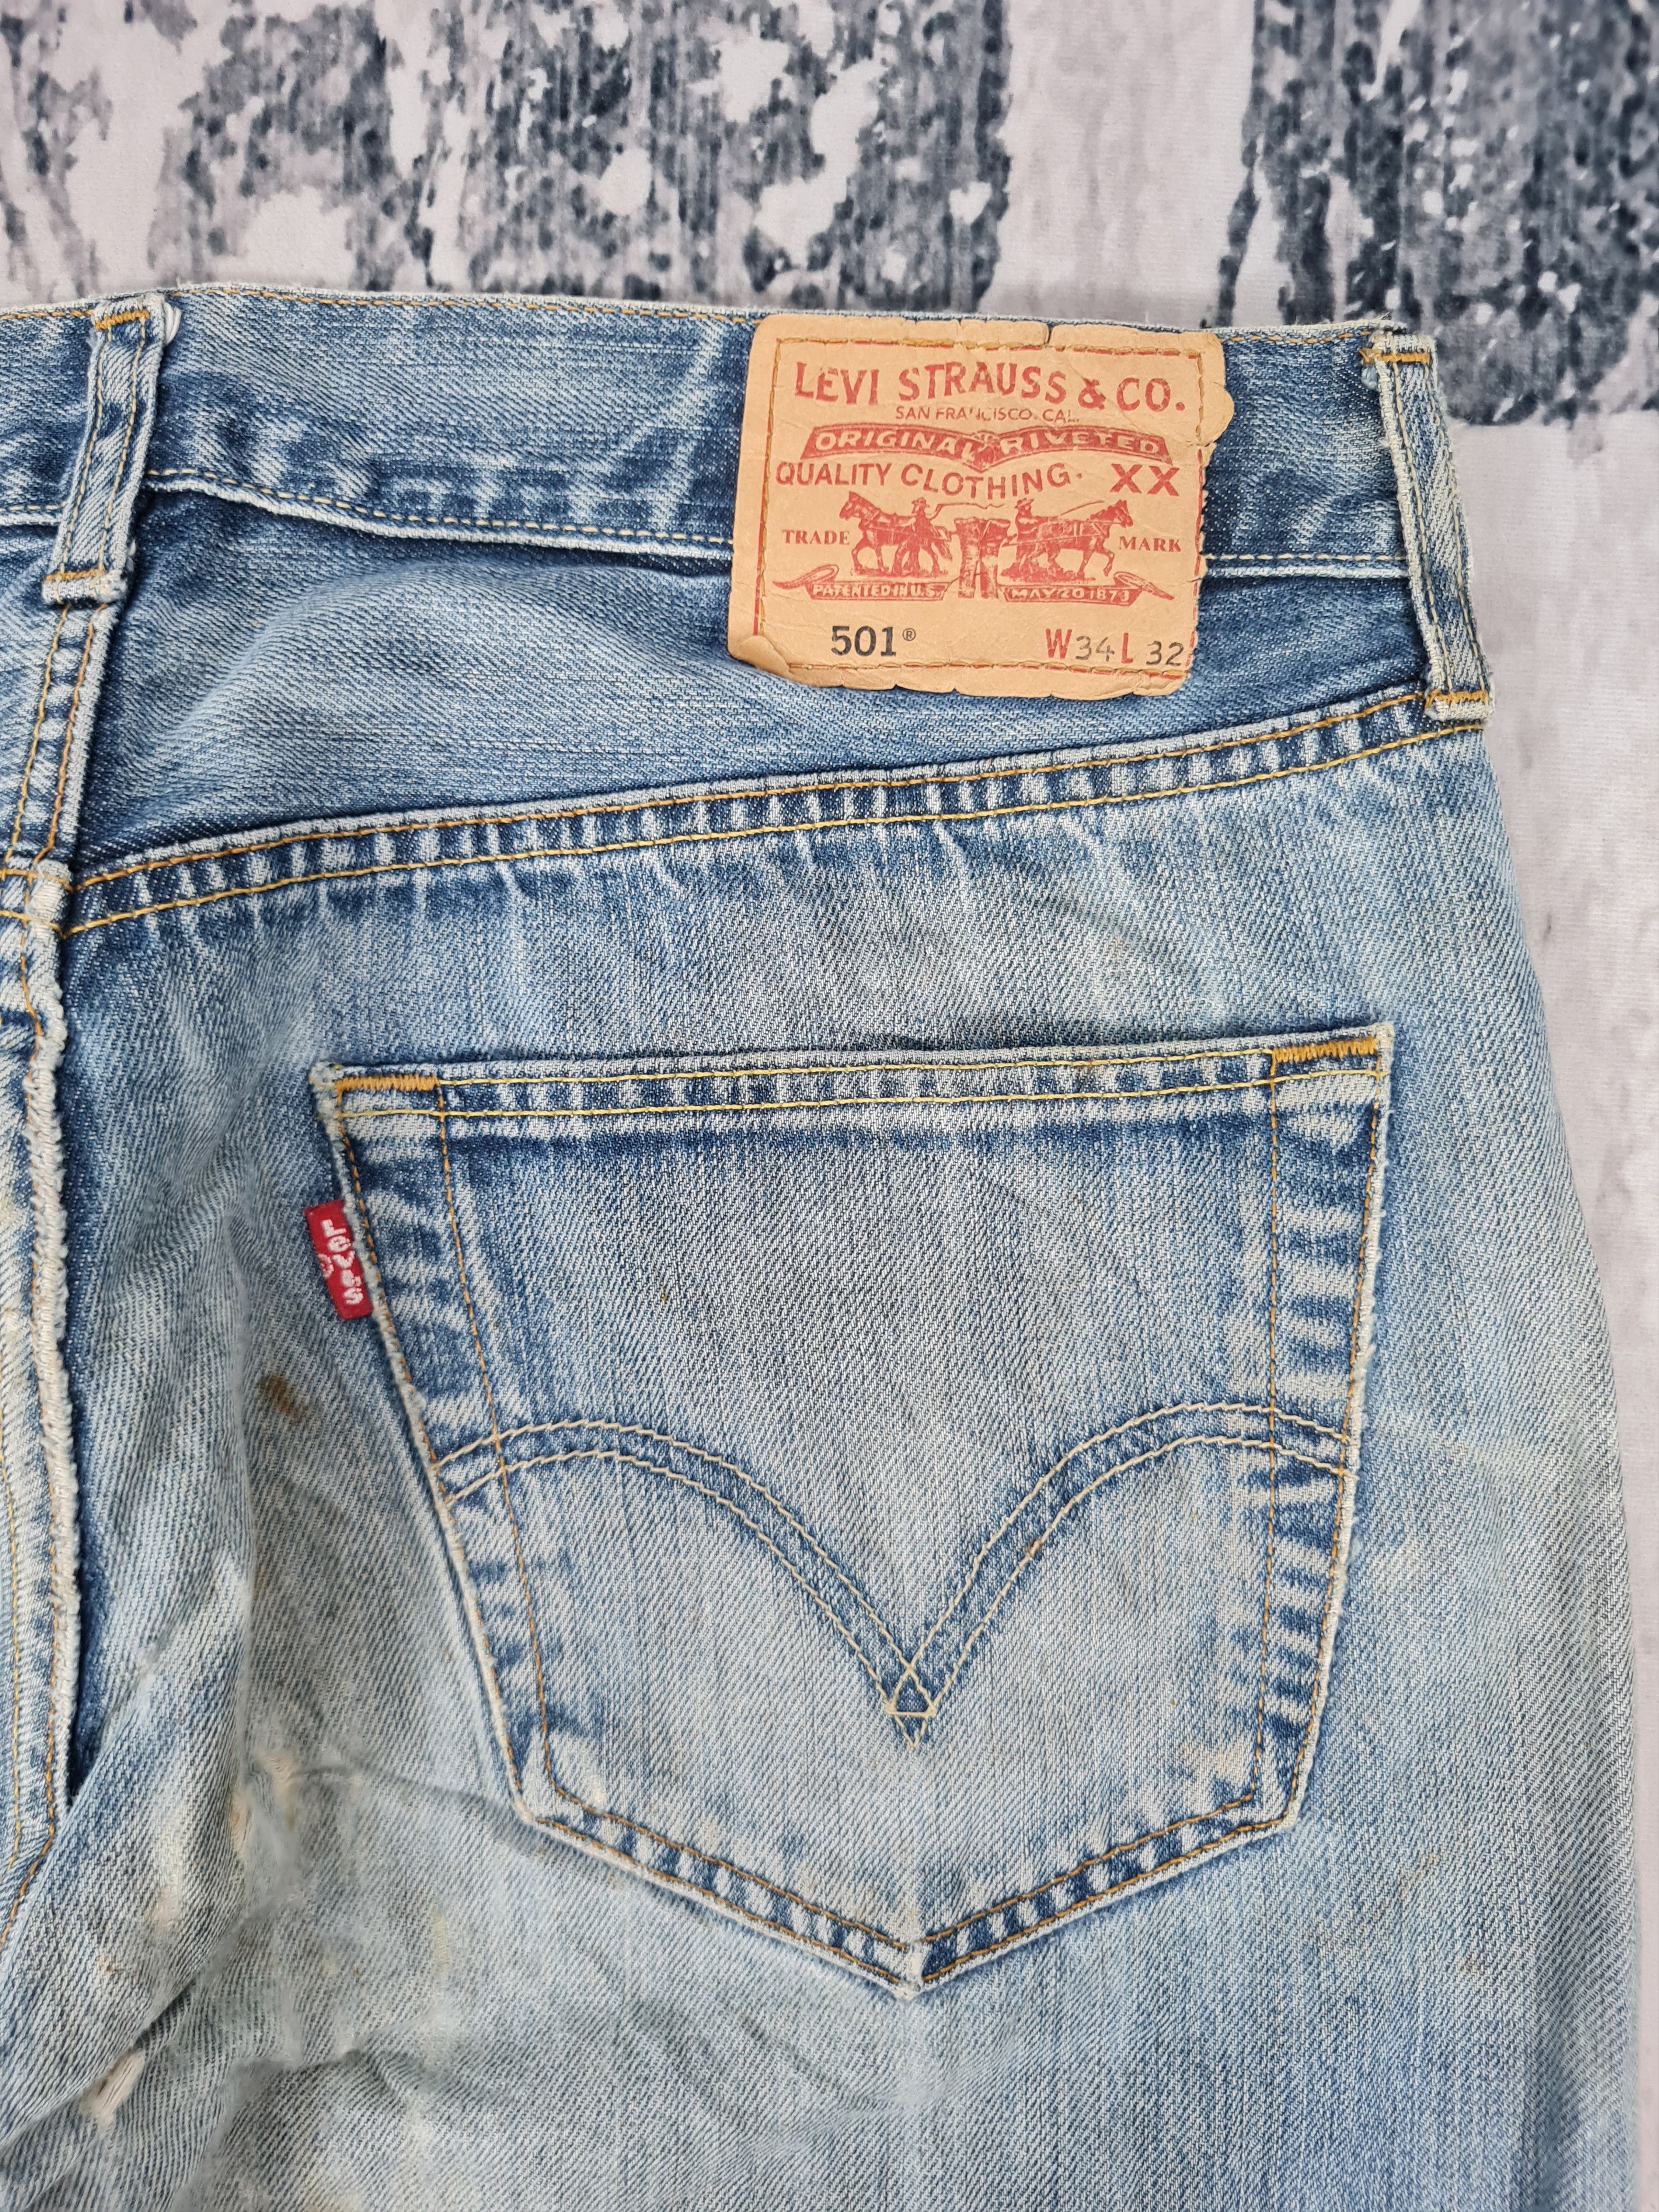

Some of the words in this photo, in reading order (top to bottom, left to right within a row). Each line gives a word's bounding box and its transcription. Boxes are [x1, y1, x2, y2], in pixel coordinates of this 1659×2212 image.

[795, 362, 879, 405] LEVI
[899, 361, 1066, 404] STRAUSS
[1078, 377, 1106, 410] &
[1117, 377, 1185, 412] CO.
[896, 405, 930, 420] SAN
[815, 430, 975, 463] ORIGINAL
[1000, 432, 1159, 455] RIVETED
[776, 462, 892, 486] QUALITY
[1110, 463, 1180, 497] XX
[782, 529, 850, 545] TRADE
[1119, 536, 1182, 552] MARK
[813, 584, 891, 598] PATENTED
[893, 584, 908, 597] IN
[1011, 588, 1056, 600] MAY
[1057, 587, 1085, 599] 20
[1090, 588, 1130, 602] 1873
